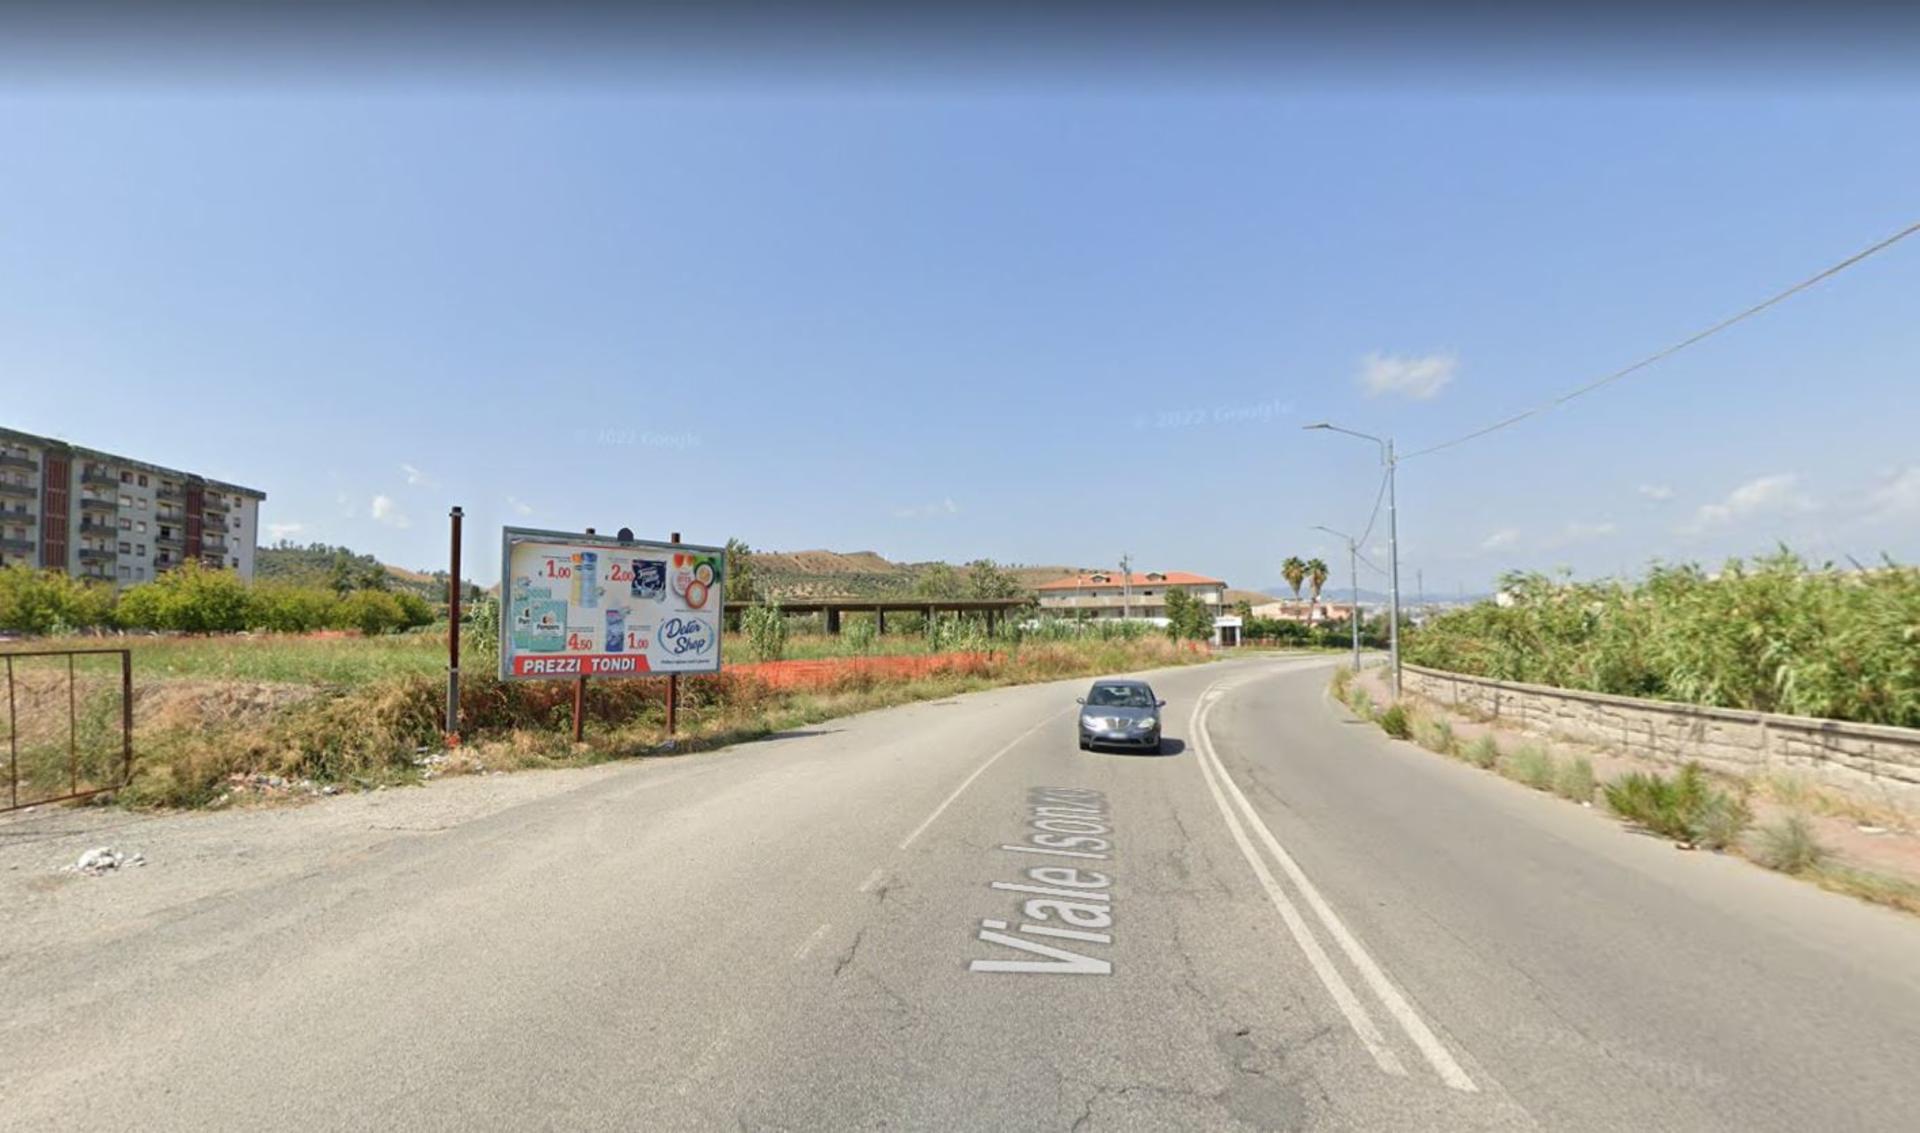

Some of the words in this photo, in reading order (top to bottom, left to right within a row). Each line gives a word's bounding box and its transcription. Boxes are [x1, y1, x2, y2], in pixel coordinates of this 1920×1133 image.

[665, 618, 701, 639] Deter
[674, 636, 706, 654] Shop
[523, 659, 581, 673] PREZZI
[591, 658, 635, 671] TONDI
